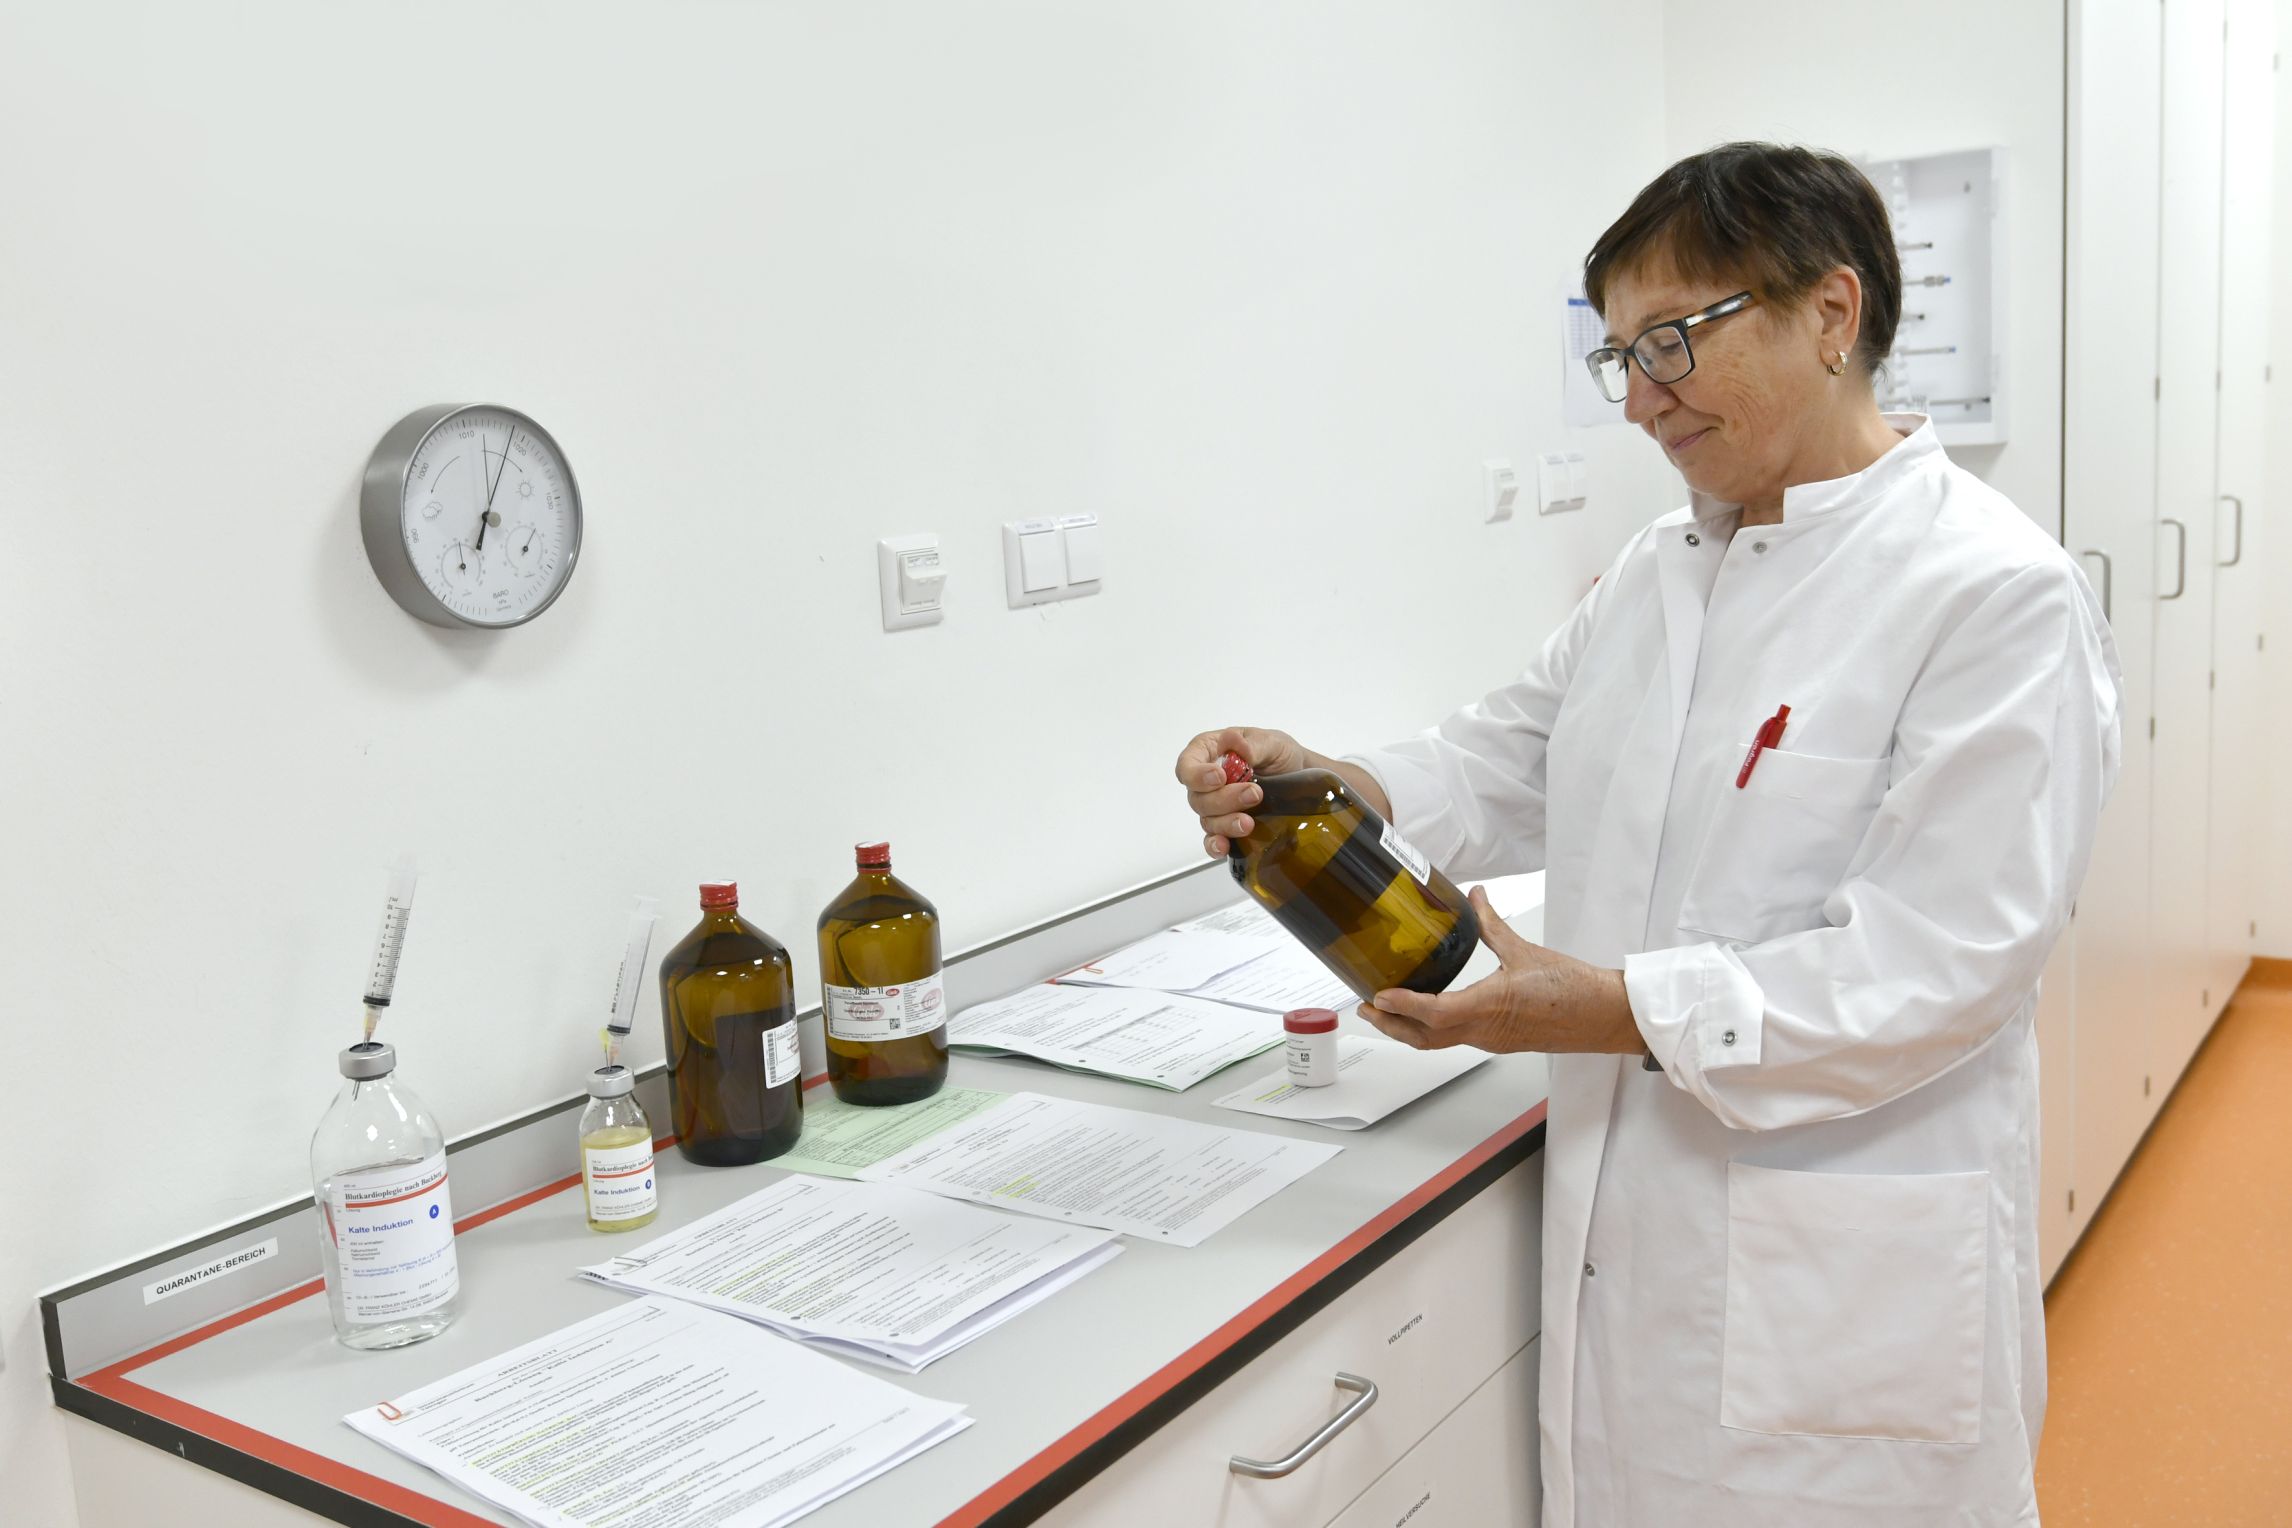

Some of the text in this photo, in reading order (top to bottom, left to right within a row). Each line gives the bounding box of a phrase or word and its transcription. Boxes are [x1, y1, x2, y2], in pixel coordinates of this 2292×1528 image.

[459, 431, 475, 439] 1010
[513, 441, 527, 456] 1020
[418, 462, 430, 480] 1000
[545, 492, 554, 509] 1030
[493, 589, 509, 599] BARO
[854, 987, 870, 995] 7350
[345, 1171, 442, 1200] Blutkardioplegie nach Buckberg
[610, 1186, 640, 1195] Induktion
[348, 1219, 413, 1234] Kalte Induktion
